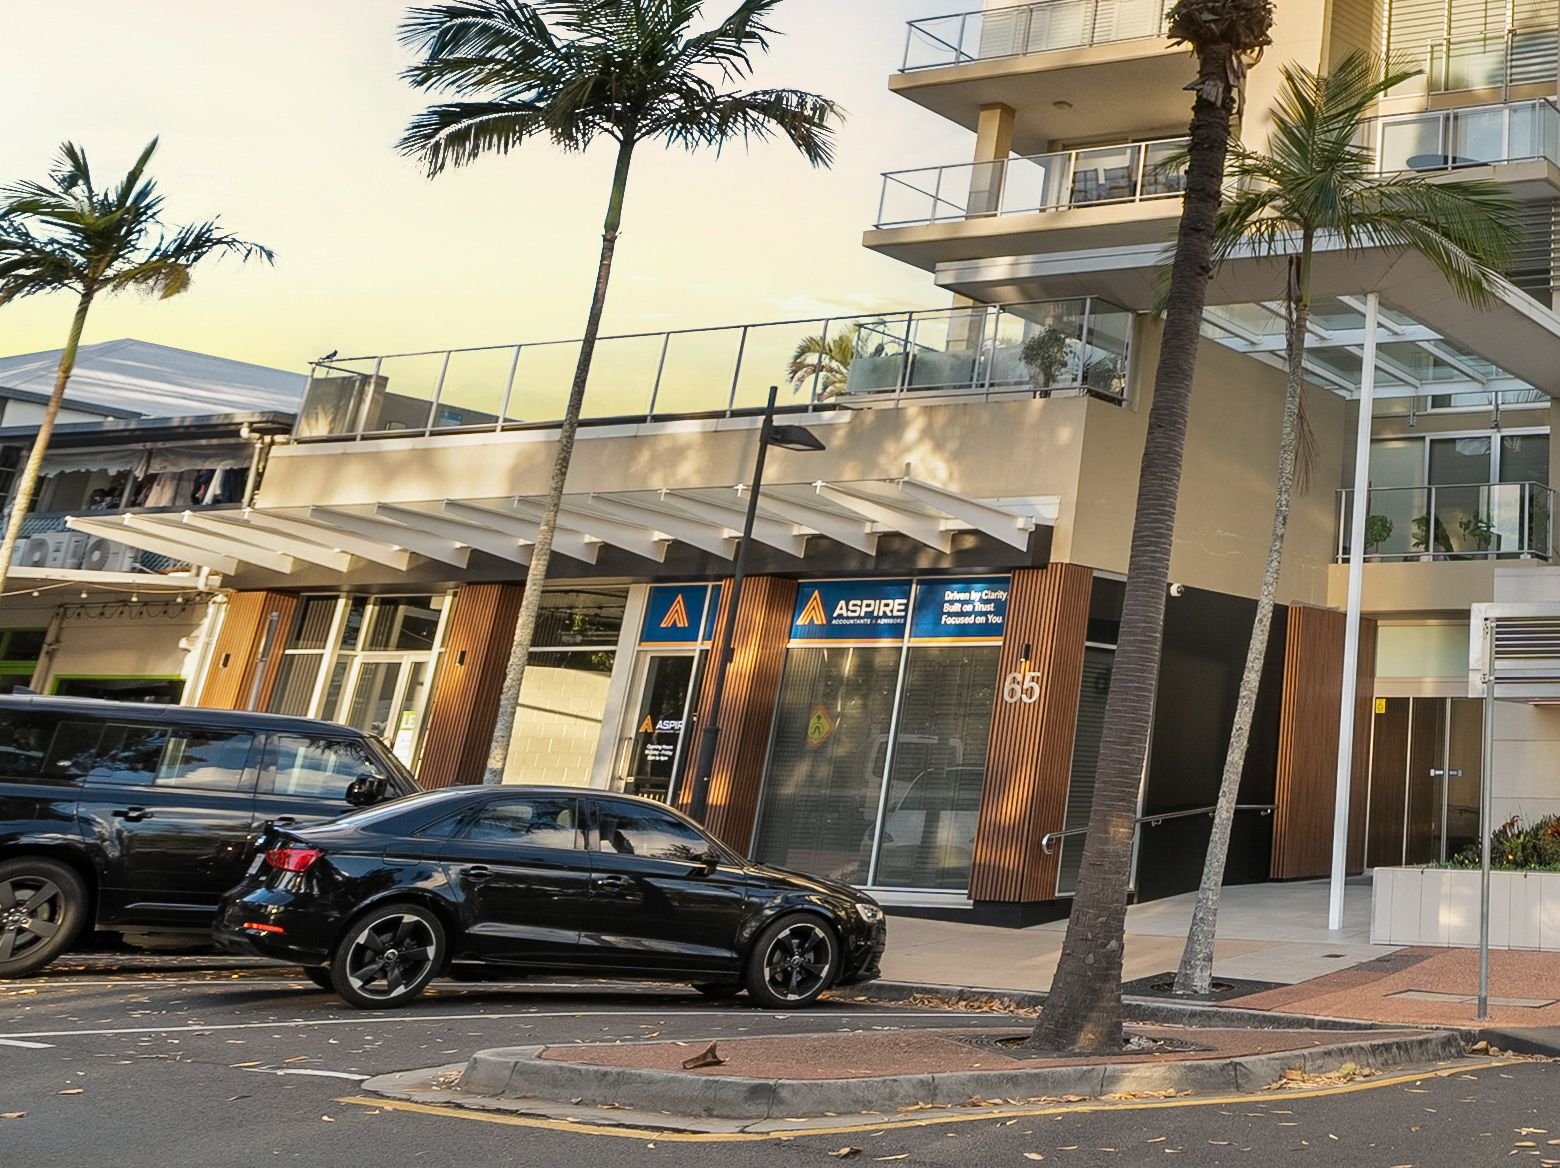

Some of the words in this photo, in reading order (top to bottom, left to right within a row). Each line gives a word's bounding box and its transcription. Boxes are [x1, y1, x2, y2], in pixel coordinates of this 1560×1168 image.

[944, 591, 970, 601] Driven
[970, 590, 981, 601] by
[832, 599, 907, 617] ASPIRE
[943, 602, 961, 612] Built
[962, 604, 973, 612] on
[941, 614, 974, 625] Focused
[975, 615, 986, 624] on
[1004, 672, 1040, 703] 65
[655, 720, 683, 729] ASPIR
